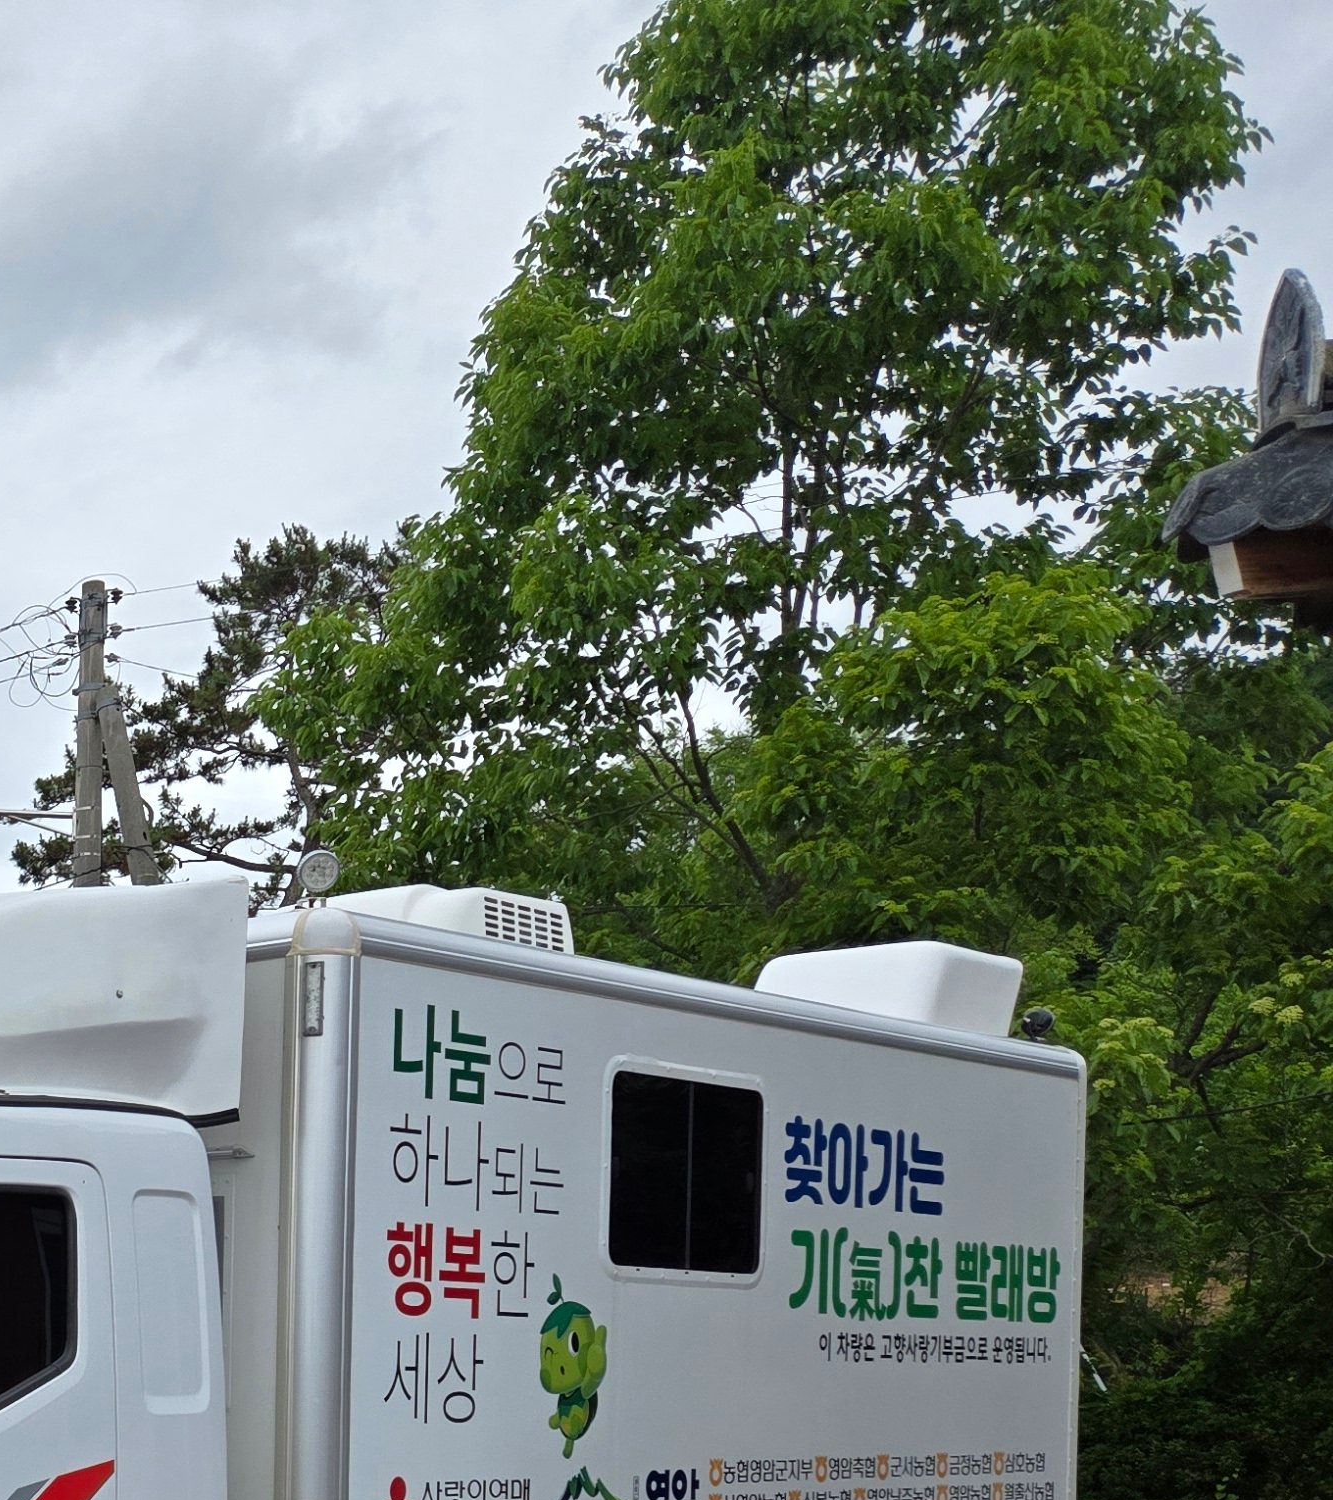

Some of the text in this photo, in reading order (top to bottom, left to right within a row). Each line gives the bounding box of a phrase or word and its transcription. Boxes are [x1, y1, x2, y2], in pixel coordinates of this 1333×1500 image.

[392, 1004, 566, 1105] 나눔으로
[389, 1113, 565, 1216] 하나되는
[784, 1115, 945, 1216] 찾아가는
[386, 1221, 535, 1320] 행복한
[789, 1226, 1061, 1324] 기(氣)찬 빨래방
[383, 1331, 484, 1424] 세상
[819, 1331, 1052, 1365] 이 차량은 고향사랑기부금으로 운영됩니다.
[723, 1452, 1046, 1484] 농협영암군지부 영암축협 군서농협 금정농협 삼호농협
